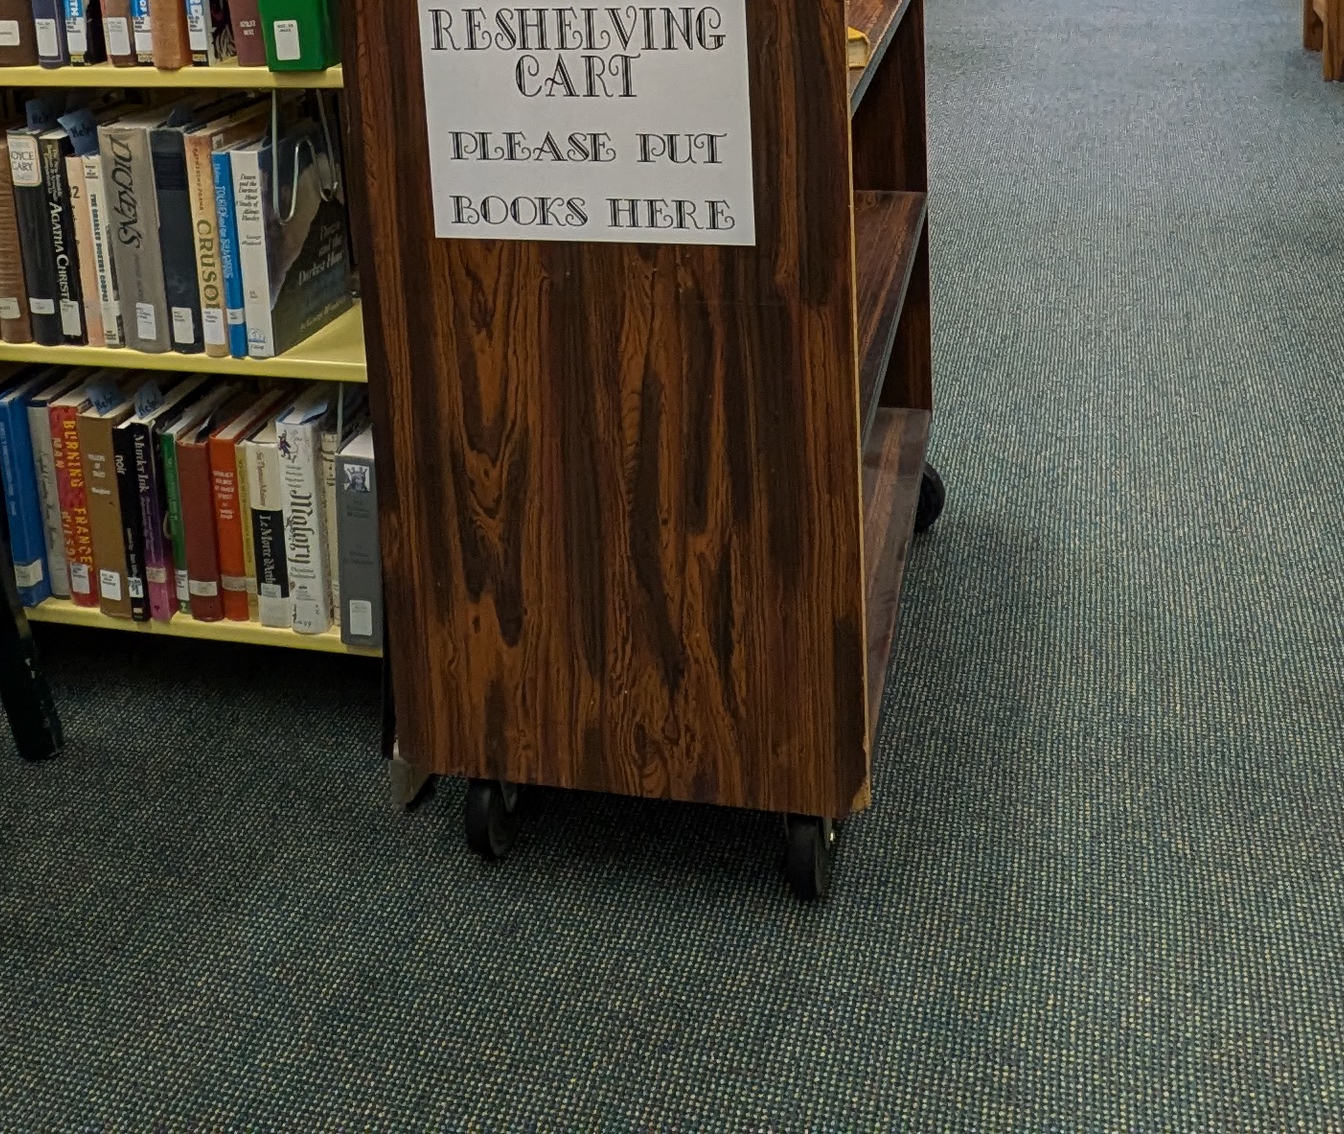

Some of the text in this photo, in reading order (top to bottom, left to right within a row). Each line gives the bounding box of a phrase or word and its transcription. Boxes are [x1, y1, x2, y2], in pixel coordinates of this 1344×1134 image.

[428, 6, 726, 51] RESHELVING
[515, 53, 641, 97] CART
[449, 131, 727, 164] PLEASE PUT
[107, 133, 143, 250] DICKENS
[449, 195, 735, 230] BOOKS HERE
[49, 200, 66, 252] AGATHA
[62, 419, 85, 489] BURNING
[115, 455, 125, 476] noir
[132, 433, 144, 471] Murder
